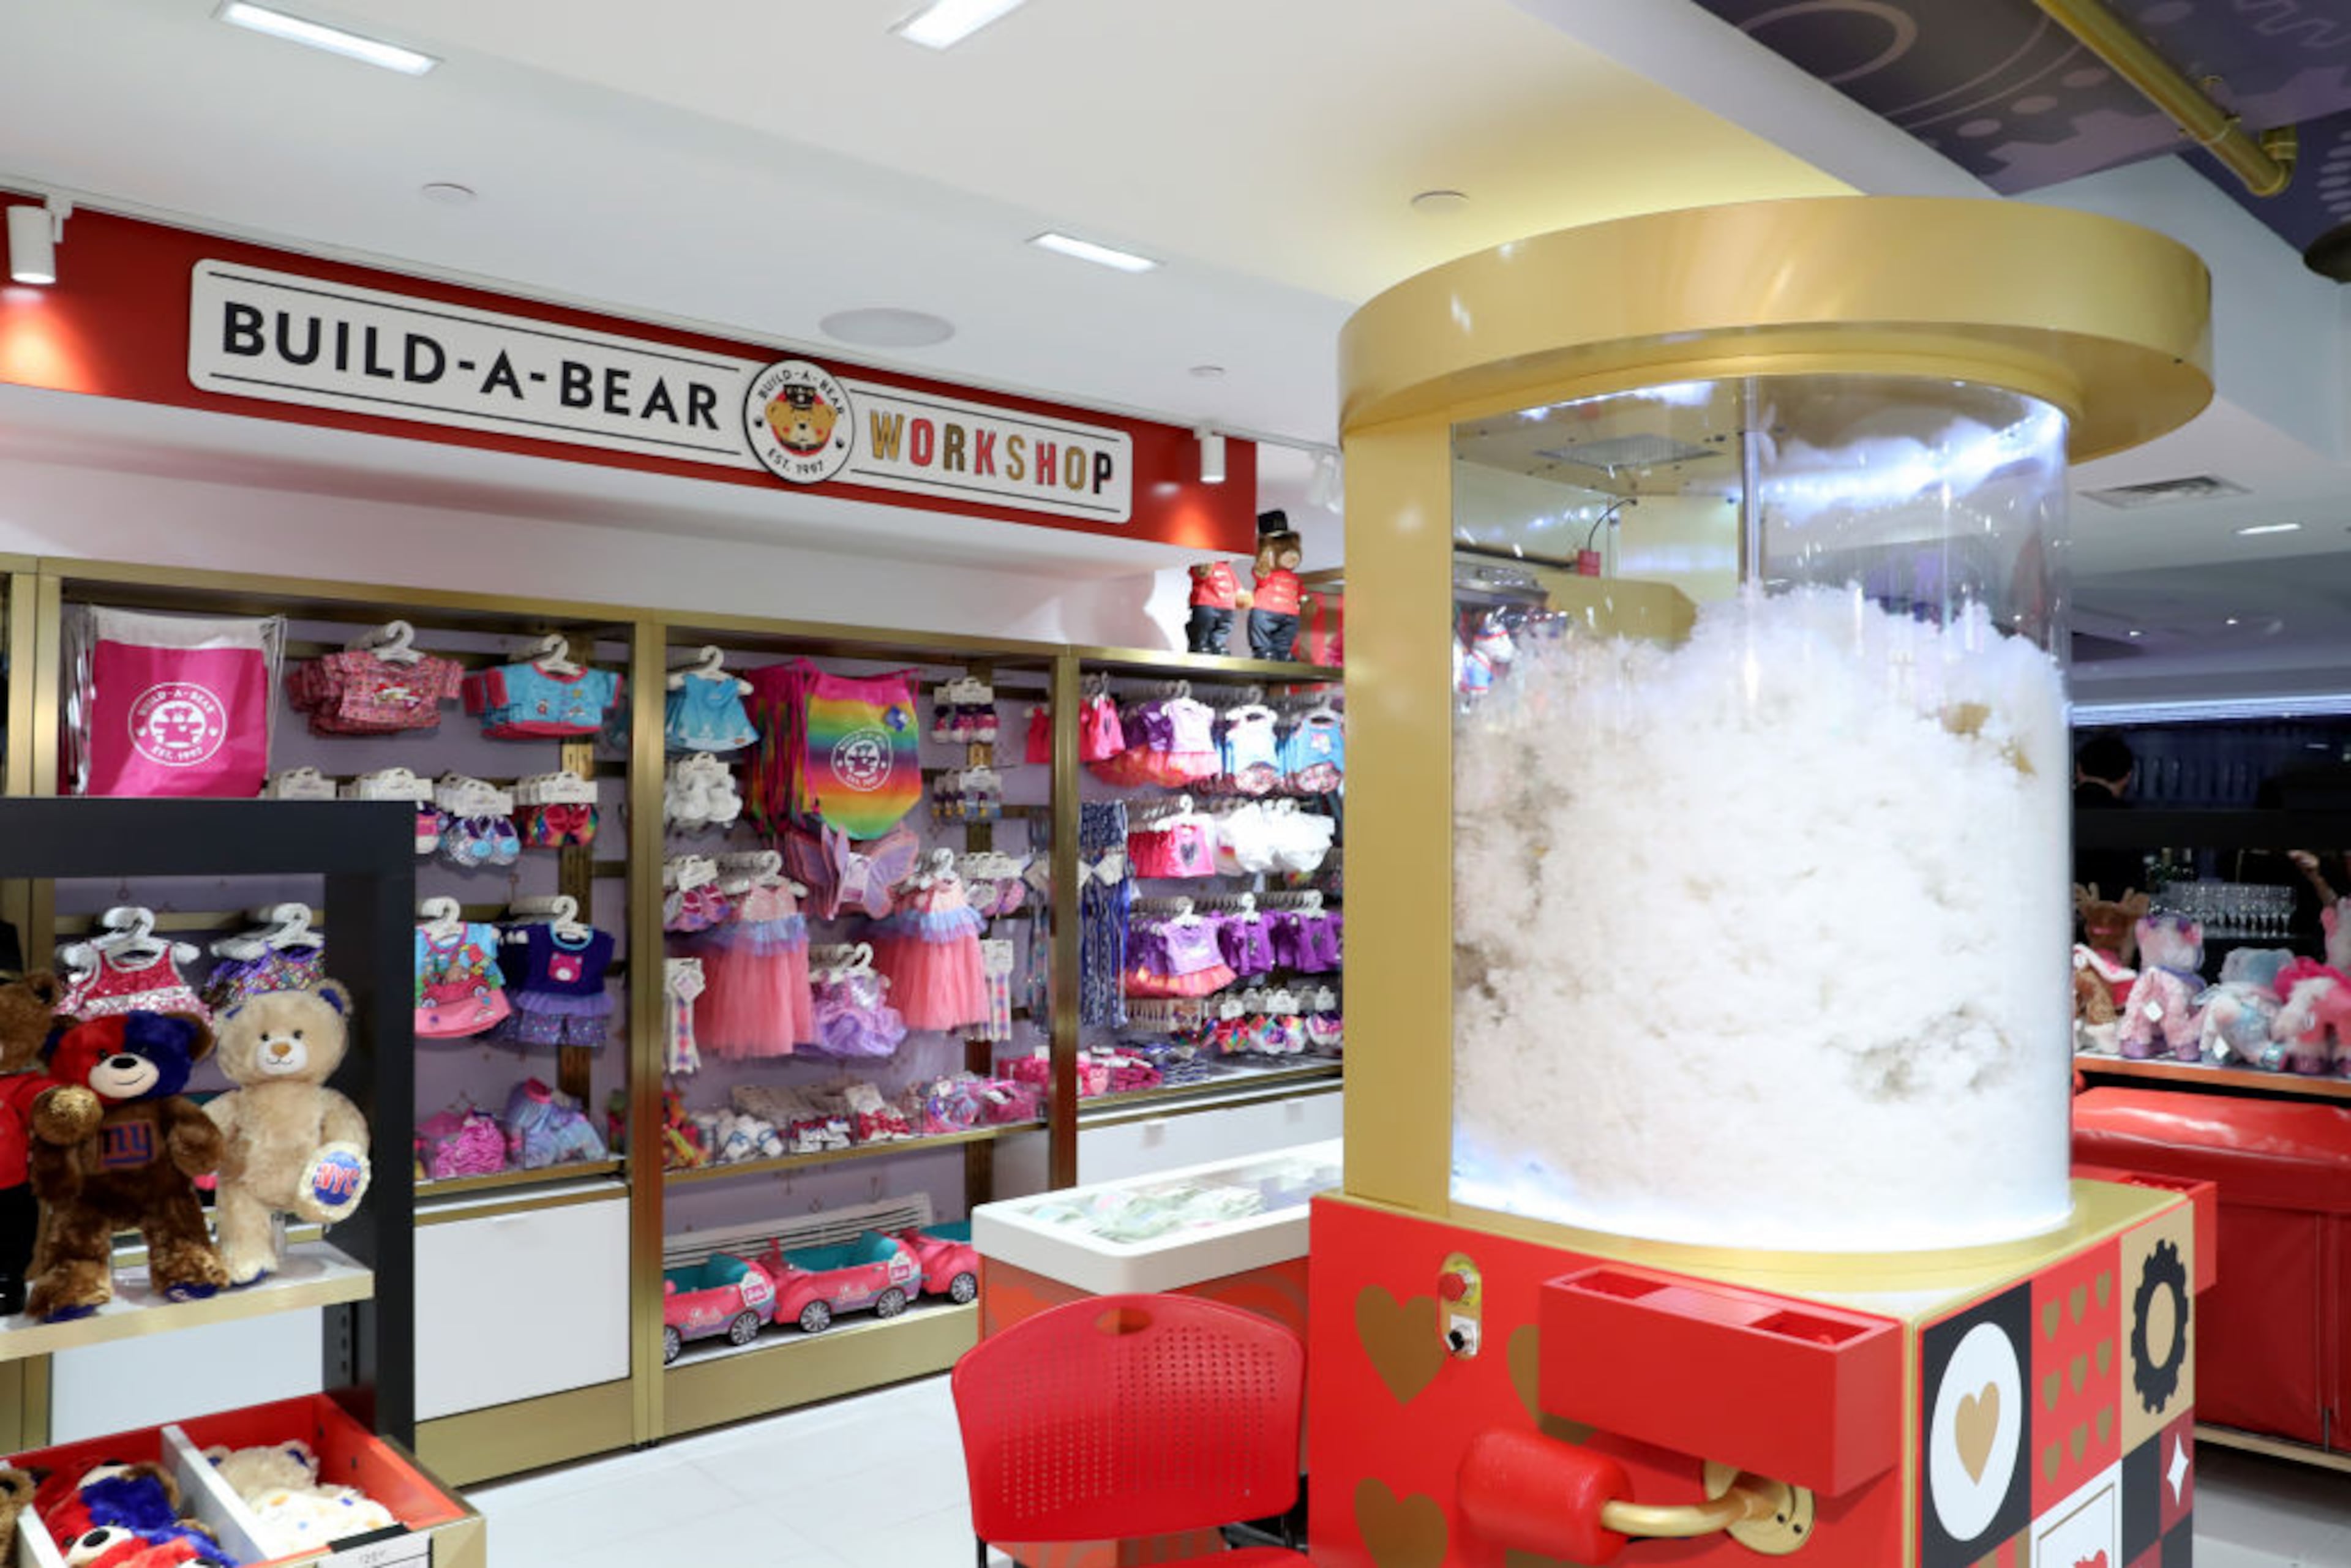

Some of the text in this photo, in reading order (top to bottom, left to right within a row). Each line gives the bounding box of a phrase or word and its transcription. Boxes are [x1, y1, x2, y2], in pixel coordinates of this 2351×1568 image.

[223, 301, 1113, 495] BUILD-A-BEAR WORKSHOP
[757, 369, 845, 416] BUILD-A-BEAR
[768, 448, 823, 474] EST. 1997
